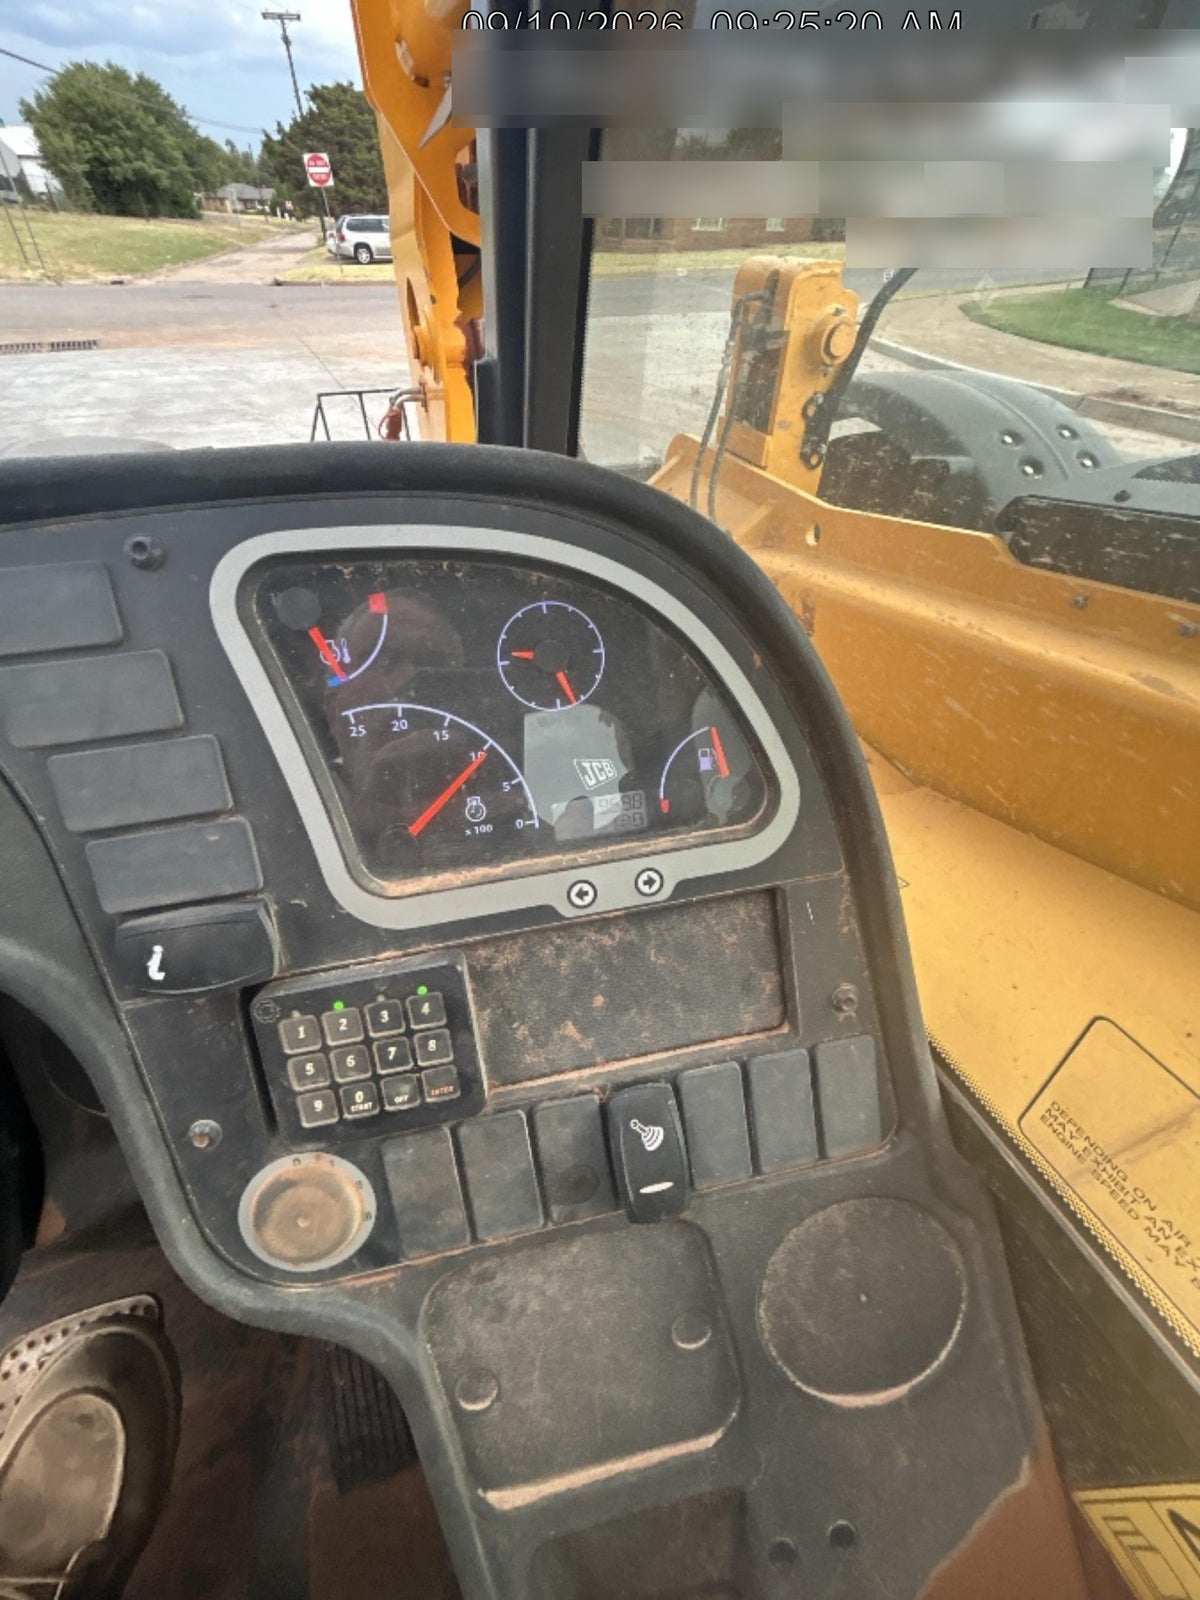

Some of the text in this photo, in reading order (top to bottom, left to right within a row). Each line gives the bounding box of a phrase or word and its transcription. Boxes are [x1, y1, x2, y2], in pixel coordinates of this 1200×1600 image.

[350, 725, 367, 737] 25
[391, 719, 408, 732] 20
[433, 730, 449, 742] 15
[580, 761, 615, 787] JCB
[502, 782, 511, 792] 5
[473, 824, 493, 835] 100
[515, 819, 524, 829] 0
[298, 1002, 430, 1039] 1 2 3 4
[305, 1039, 437, 1075] 5 6 7 8
[314, 1091, 364, 1112] 9 0
[1045, 1107, 1080, 1141] MAY
[1143, 1216, 1172, 1241] AN
[1050, 1100, 1192, 1248] DEPENDING ON AIR
[1040, 1114, 1087, 1164] ENGINE
[1091, 1168, 1139, 1221] SPEED
[1144, 1226, 1187, 1268] MAY
